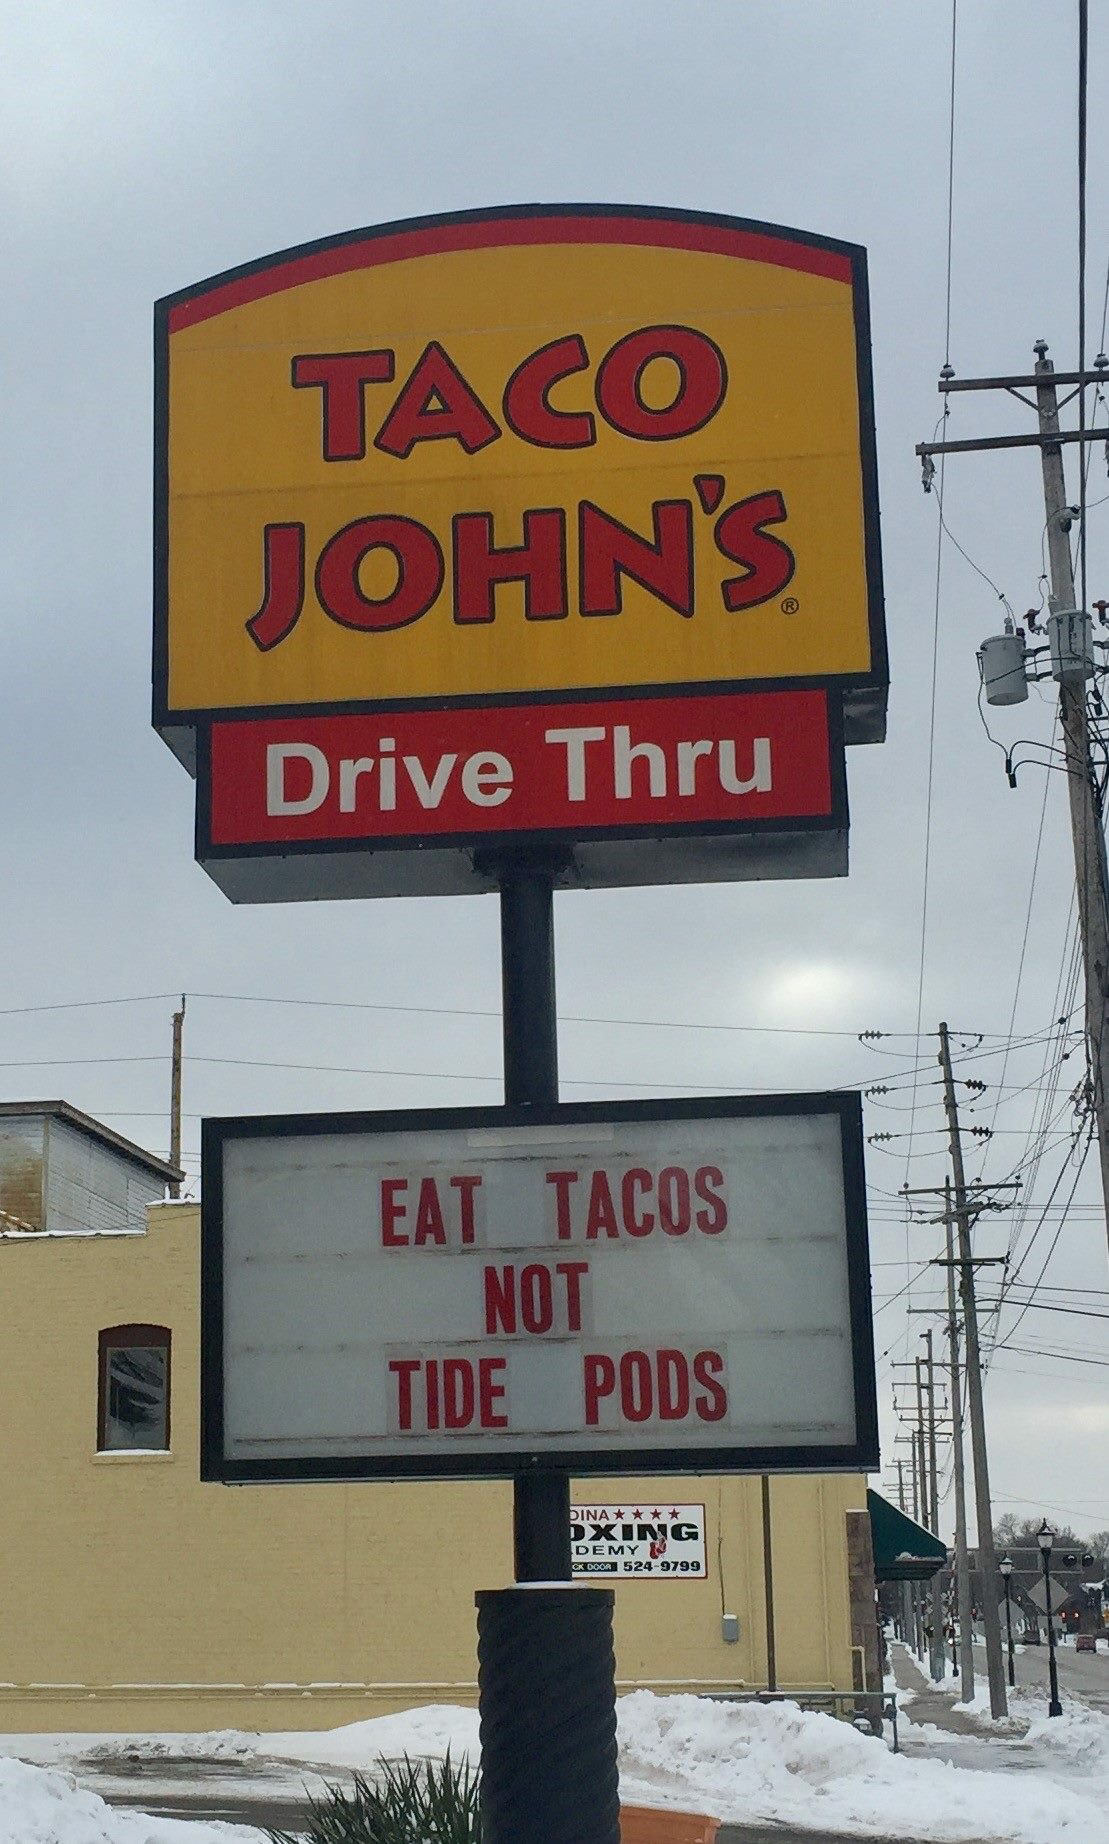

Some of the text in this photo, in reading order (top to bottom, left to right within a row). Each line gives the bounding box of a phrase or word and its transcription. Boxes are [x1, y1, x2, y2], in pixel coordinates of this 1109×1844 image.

[291, 324, 728, 462] TACO
[246, 474, 797, 652] JOHN'S
[266, 726, 774, 818] Drive Thru
[380, 1165, 729, 1247] EAT TACOS
[484, 1262, 589, 1335] NOT
[388, 1349, 729, 1431] TIDE PODS
[623, 1561, 701, 1572] 524-9799
